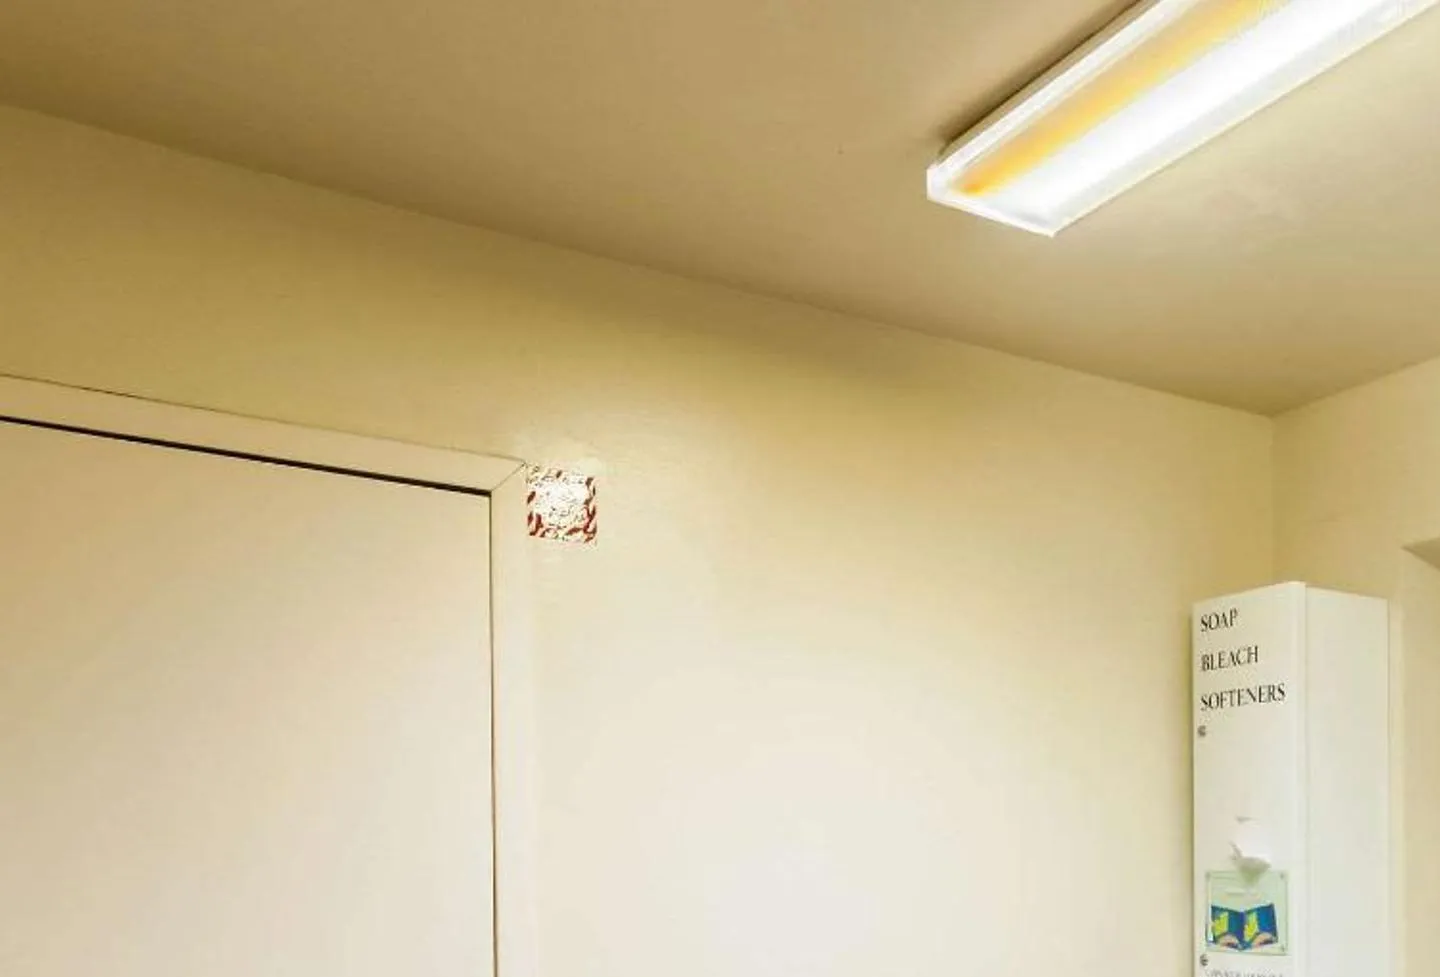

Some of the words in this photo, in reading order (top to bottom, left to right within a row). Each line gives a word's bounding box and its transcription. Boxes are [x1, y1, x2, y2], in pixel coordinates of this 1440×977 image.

[1200, 608, 1238, 632] SOAP
[1201, 645, 1258, 671] BLEACH
[1200, 682, 1286, 711] SOFTENERS
